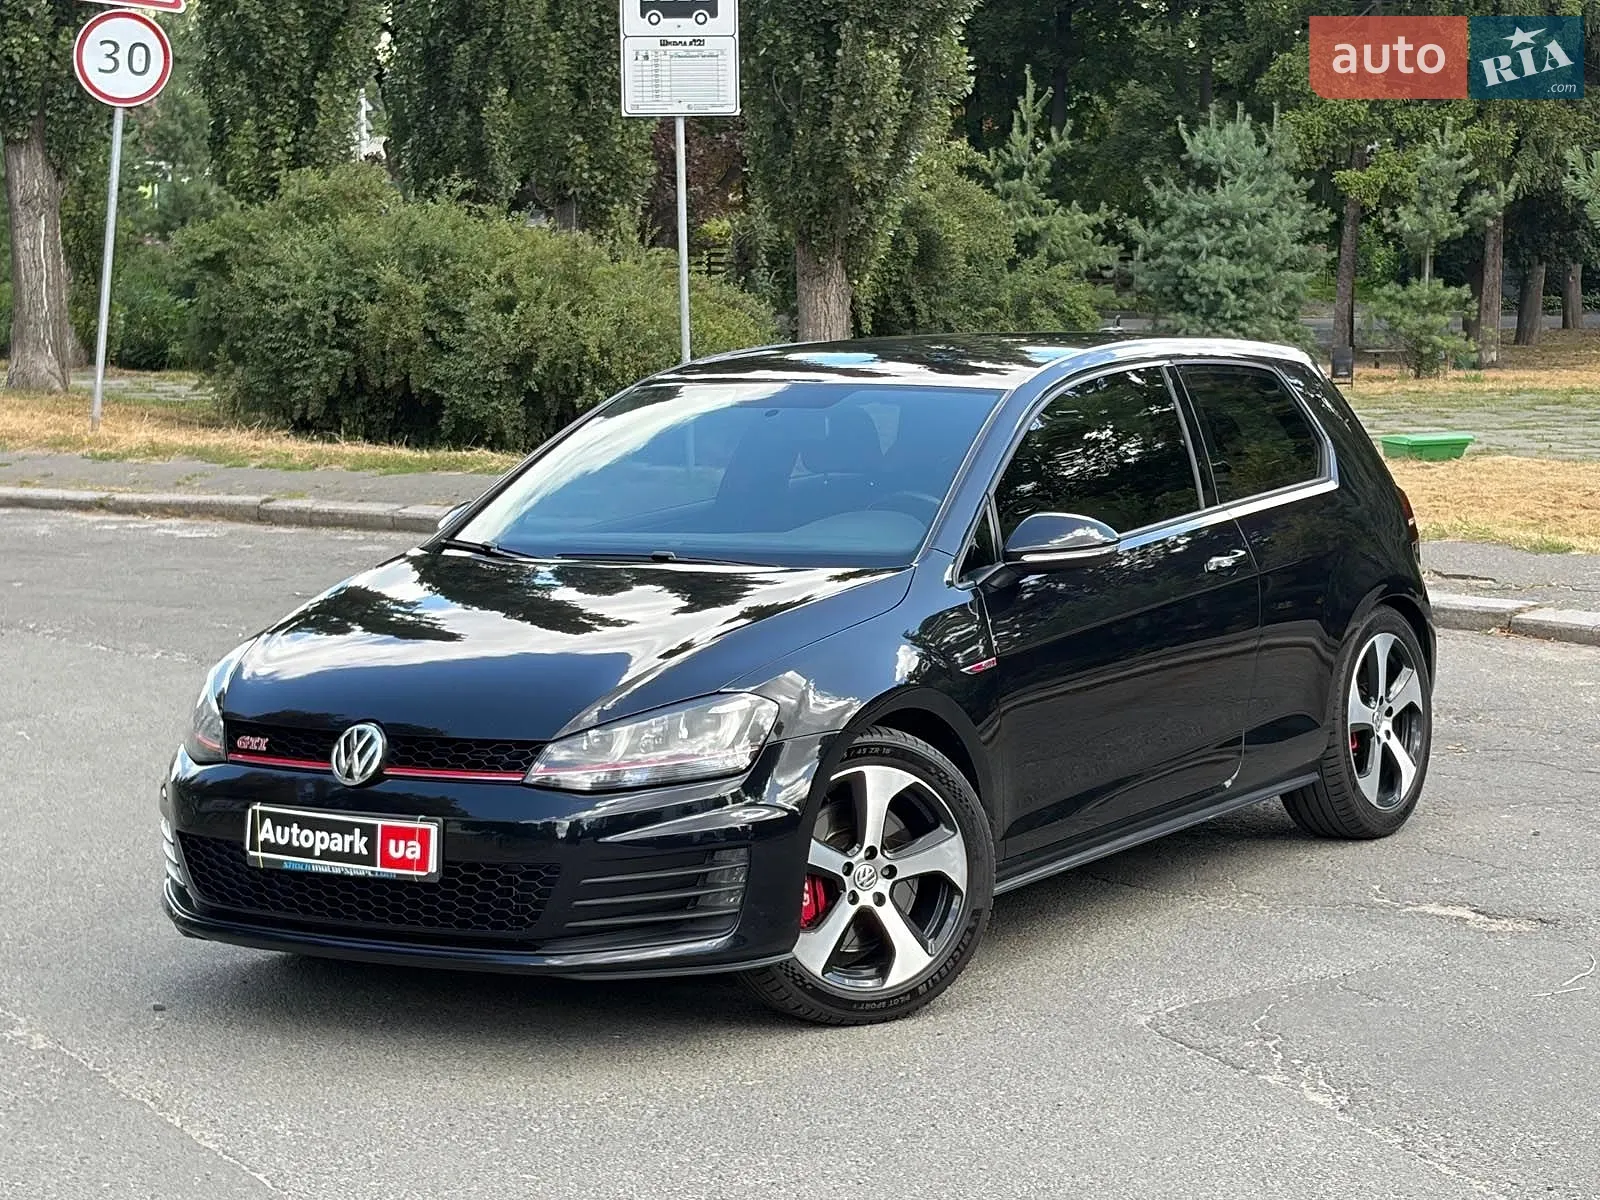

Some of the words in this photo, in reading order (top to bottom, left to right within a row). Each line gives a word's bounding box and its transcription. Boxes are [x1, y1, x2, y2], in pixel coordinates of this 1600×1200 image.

[98, 40, 151, 76] 30
[236, 735, 269, 751] GTI
[259, 818, 369, 856] Autopark
[388, 837, 421, 861] ua
